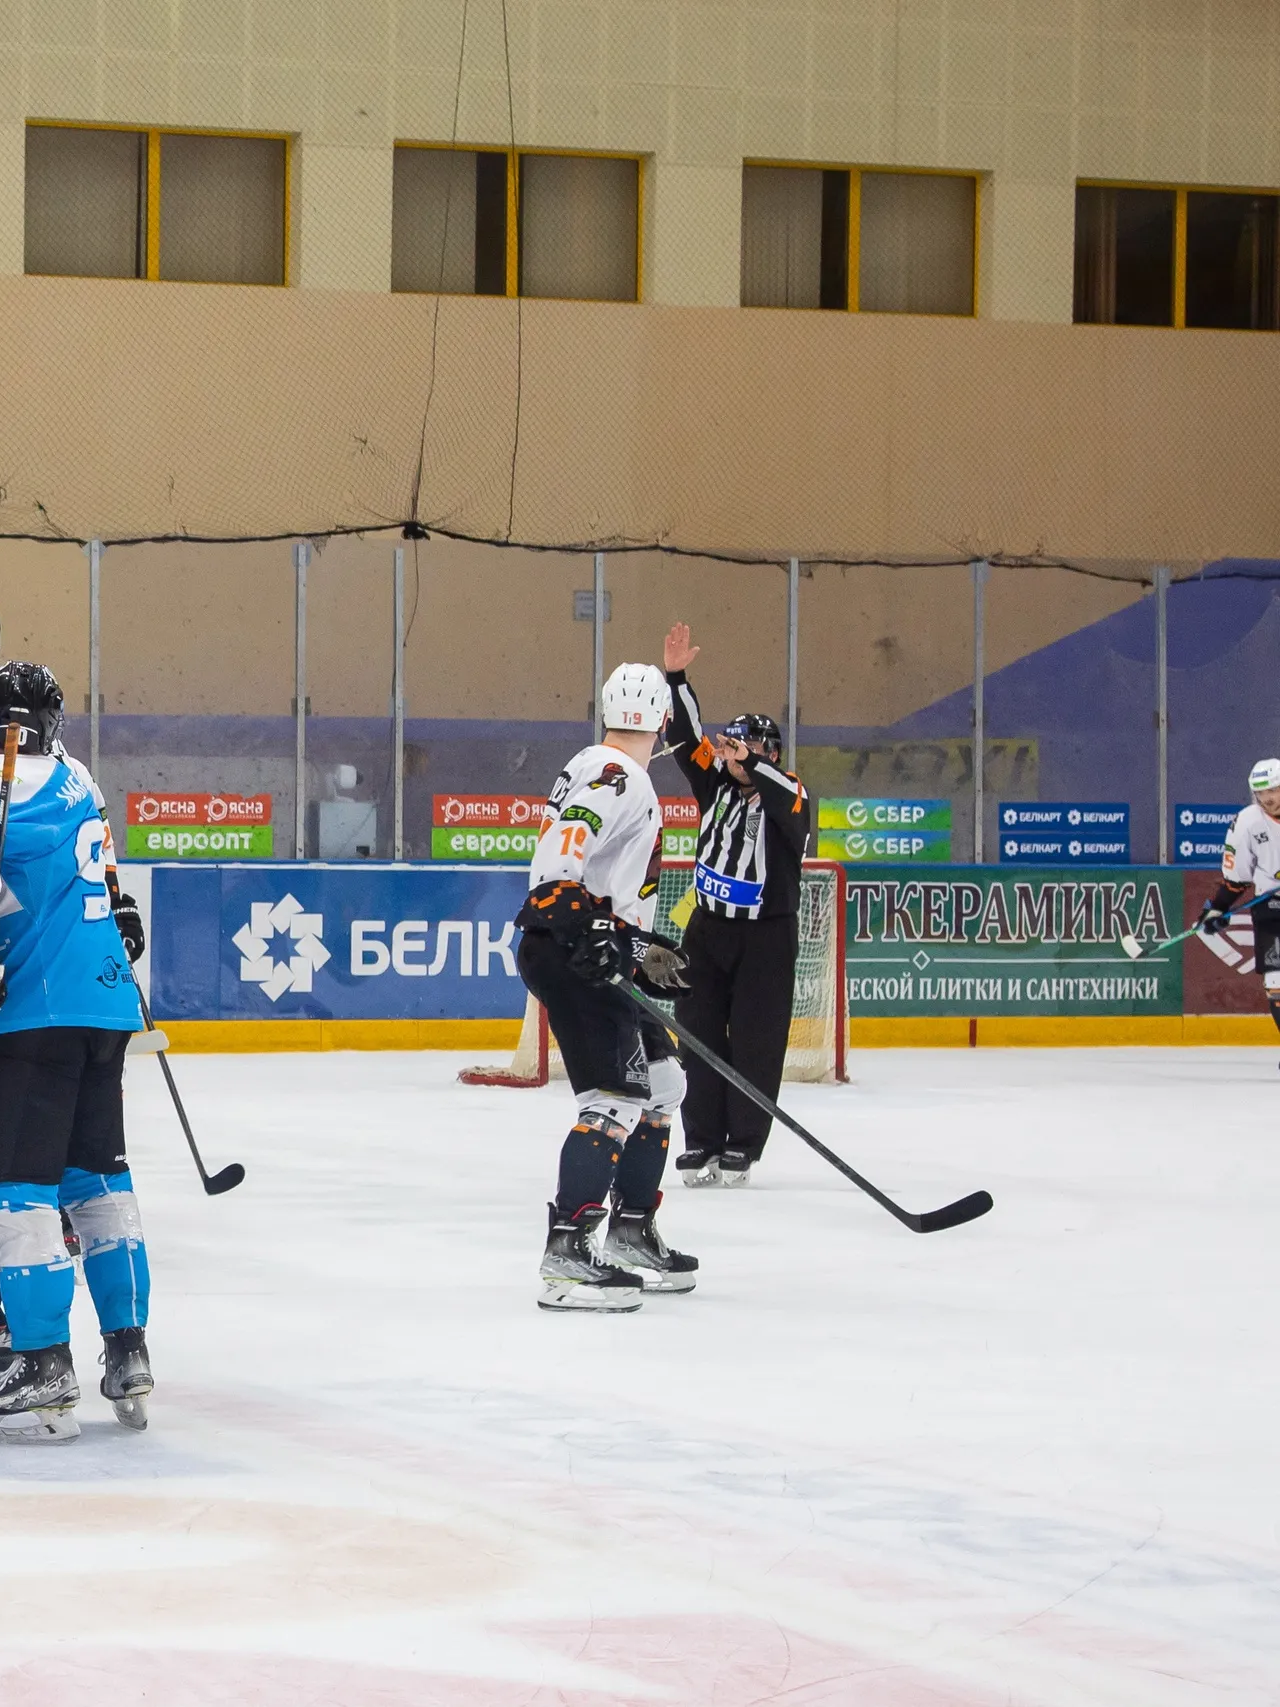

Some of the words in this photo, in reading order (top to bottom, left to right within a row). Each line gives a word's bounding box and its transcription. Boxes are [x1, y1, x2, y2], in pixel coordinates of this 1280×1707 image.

[622, 712, 642, 725] 19
[873, 806, 925, 824] СБЕР
[1019, 811, 1062, 823] БЕЛКАРТ
[1083, 812, 1125, 823] БЕЛКАРТ
[147, 832, 253, 856] евроопт
[451, 834, 538, 857] еврооп
[872, 838, 924, 855] СБЕР
[1019, 842, 1062, 854] БЕЛКАРТ
[1083, 842, 1126, 854] БЕЛКАРТ
[703, 876, 732, 898] ВТБ
[350, 920, 519, 977] БЕЛК
[849, 972, 913, 1000] ЕСКОЙ
[920, 977, 1002, 1000] ПЛИТКИ
[1008, 977, 1021, 1000] И
[1026, 977, 1159, 1000] САНТЕХНИКИ
